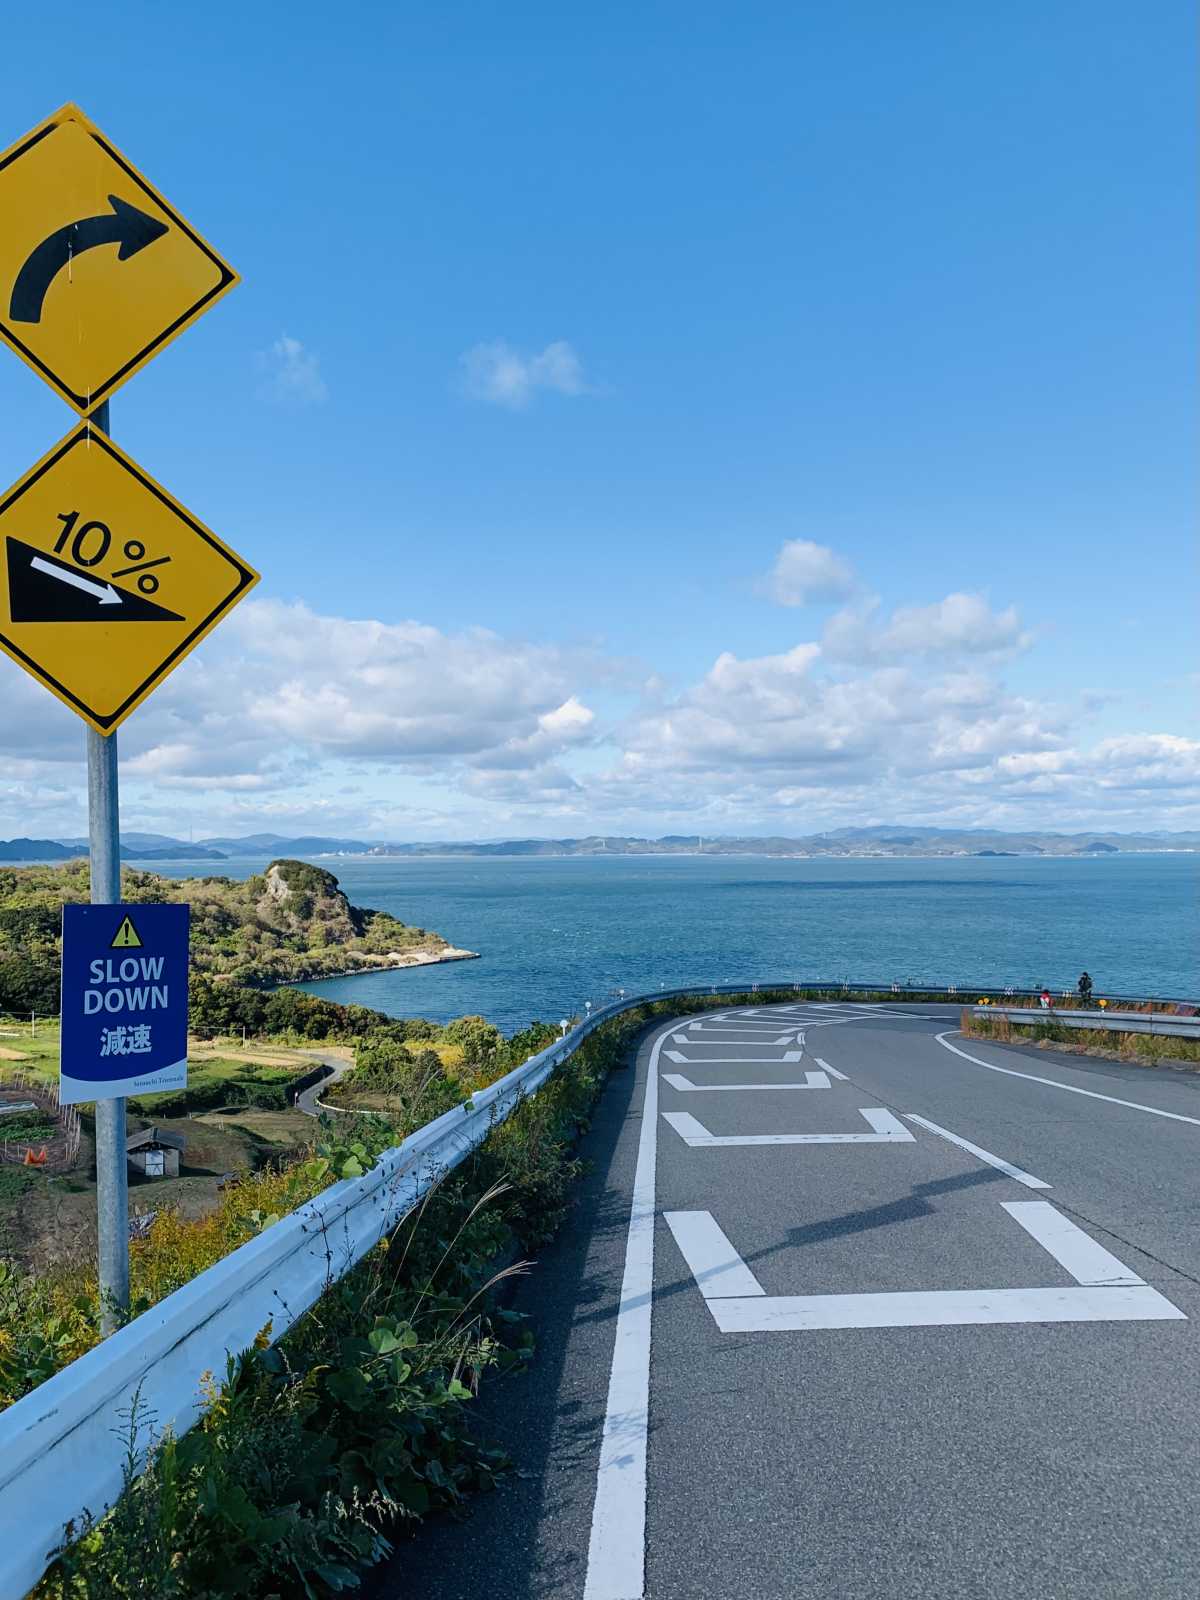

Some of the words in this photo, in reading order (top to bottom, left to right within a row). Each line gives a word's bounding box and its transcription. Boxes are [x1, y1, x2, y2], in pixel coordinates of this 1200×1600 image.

[53, 511, 171, 594] 10%
[89, 956, 165, 984] SLOW
[84, 985, 168, 1015] DOWN
[100, 1023, 152, 1057] 減速
